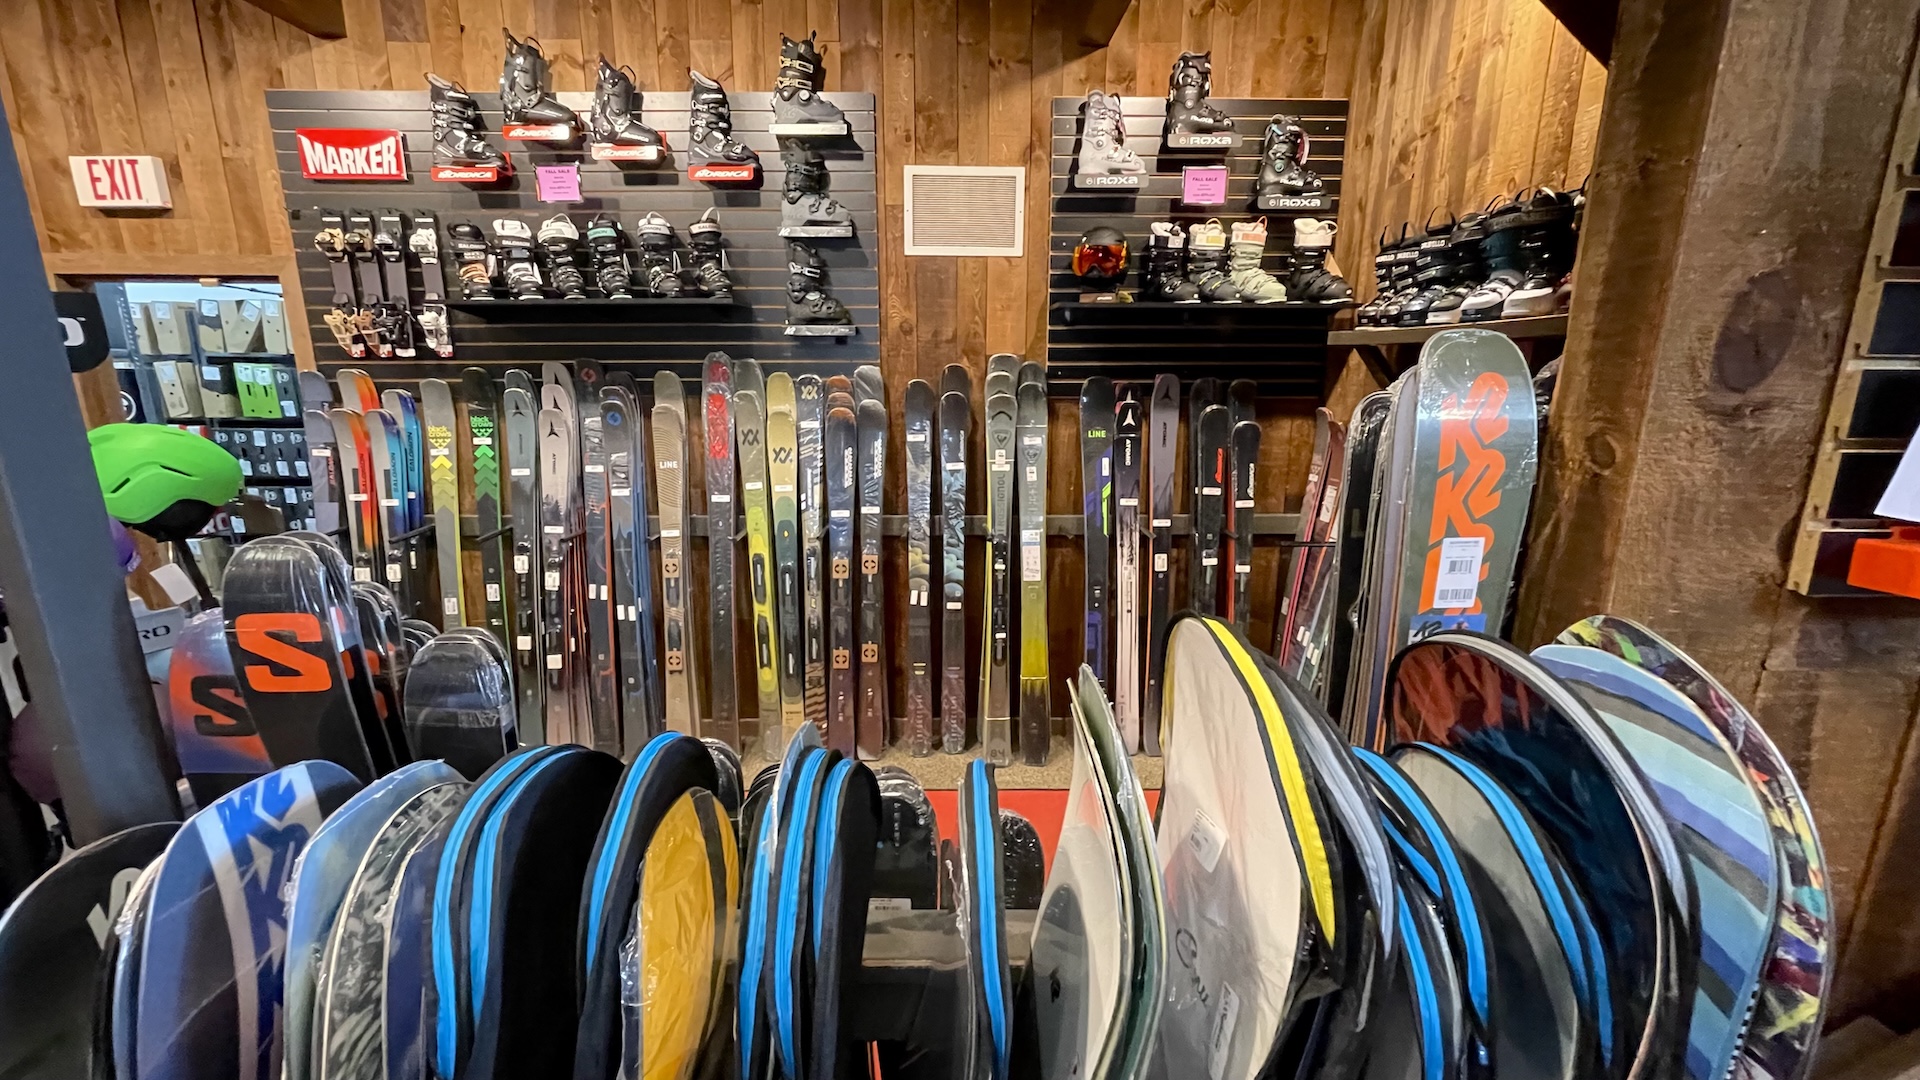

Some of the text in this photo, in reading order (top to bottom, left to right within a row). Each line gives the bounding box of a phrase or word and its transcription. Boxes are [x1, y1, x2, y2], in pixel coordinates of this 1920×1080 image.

[297, 134, 398, 174] MARKER
[438, 170, 492, 178] NORDICA
[694, 168, 749, 178] NORDICA
[86, 159, 143, 200] EXIT
[1088, 430, 1107, 438] LINE
[1438, 371, 1509, 472] K2
[235, 612, 332, 692] S
